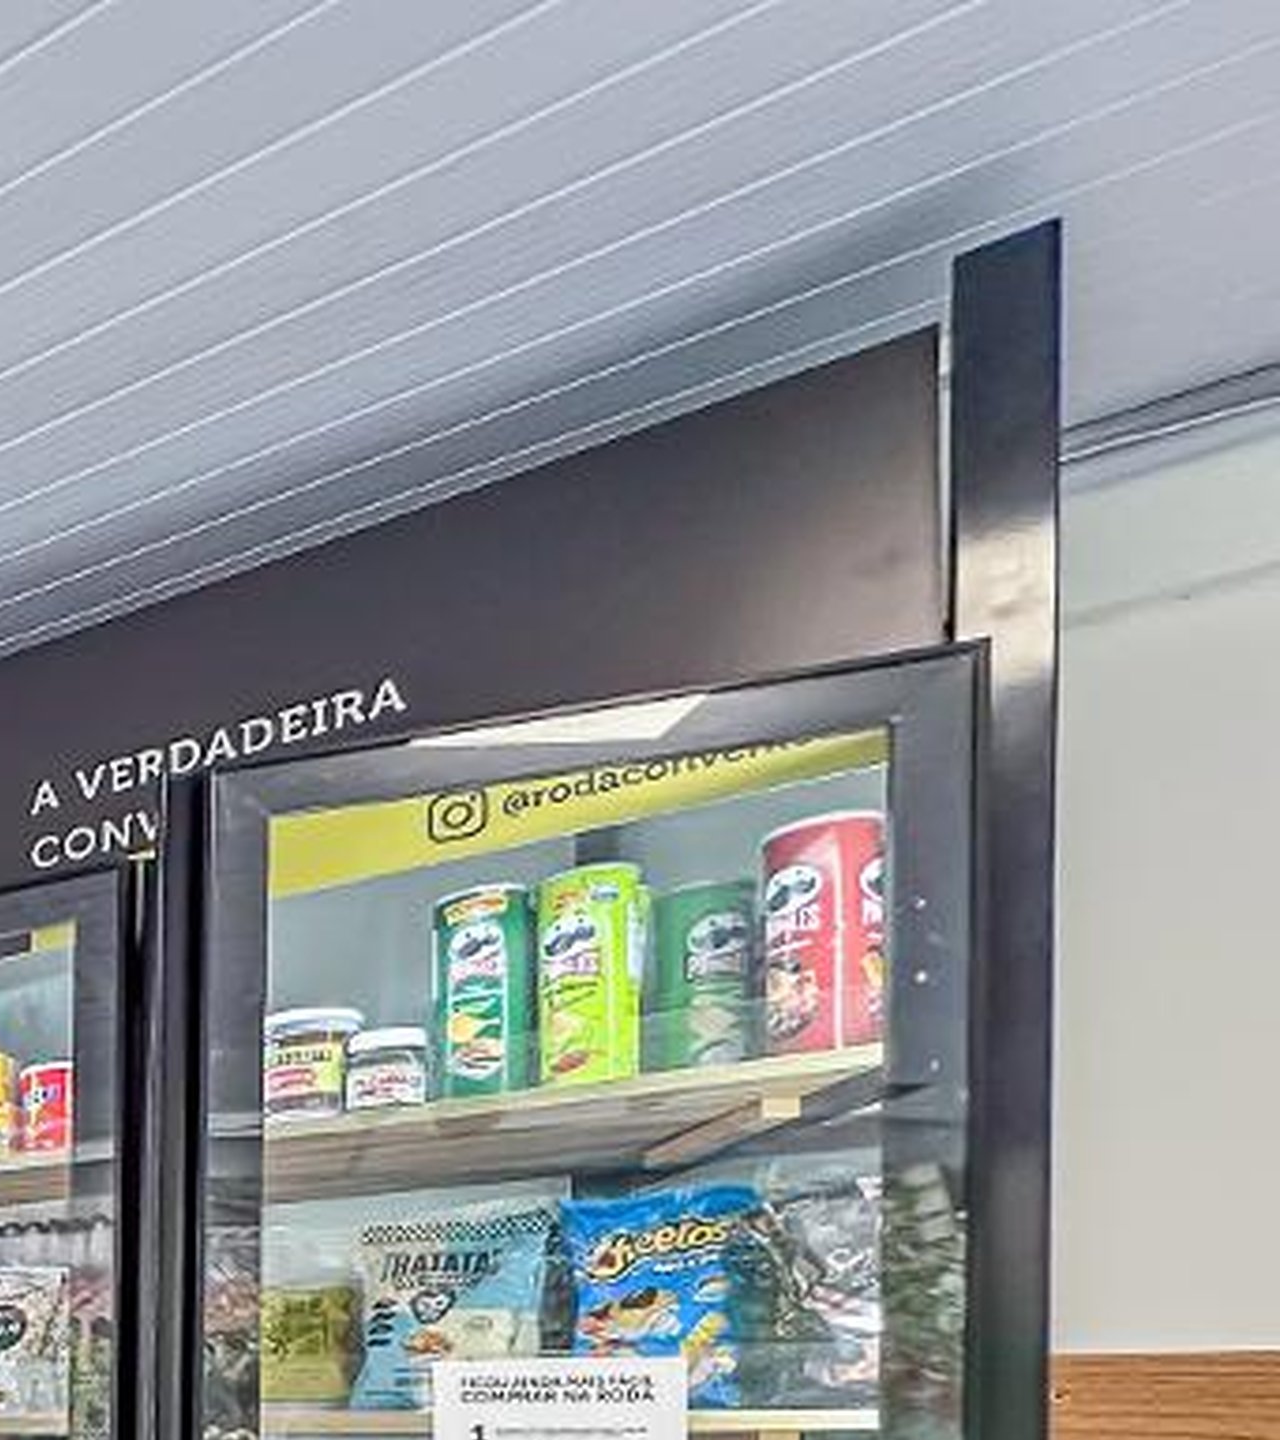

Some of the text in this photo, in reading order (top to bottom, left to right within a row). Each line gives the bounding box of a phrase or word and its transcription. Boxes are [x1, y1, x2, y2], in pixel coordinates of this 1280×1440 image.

[30, 677, 407, 816] A VERDADEIRA
[586, 1217, 729, 1281] Cheetos
